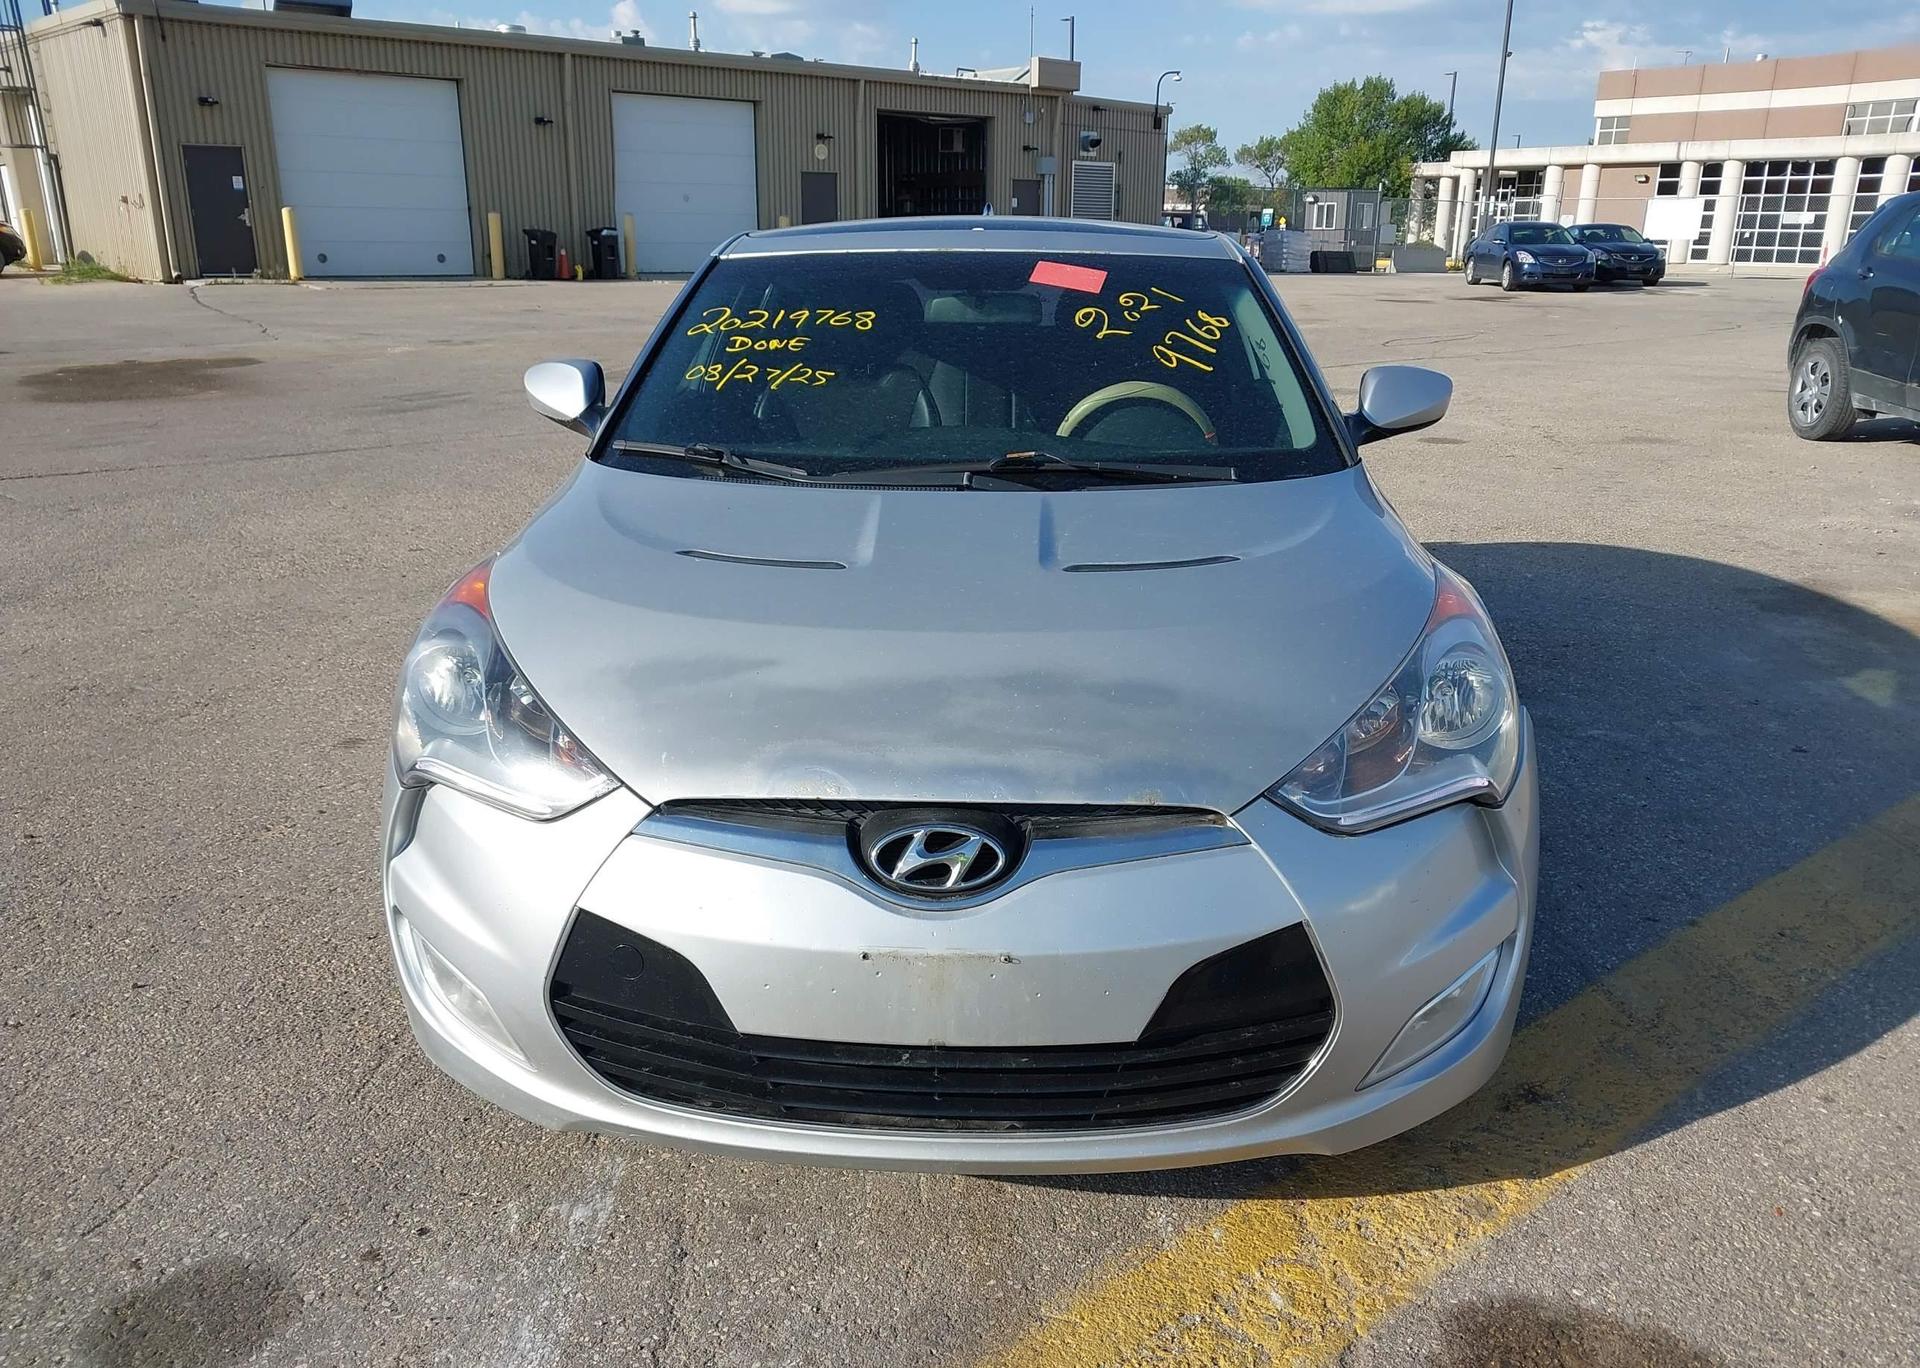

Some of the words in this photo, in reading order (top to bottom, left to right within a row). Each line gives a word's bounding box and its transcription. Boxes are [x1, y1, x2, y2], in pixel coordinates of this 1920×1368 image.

[686, 307, 877, 336] 20219768
[725, 335, 811, 352] DONE
[1152, 310, 1231, 371] 9768
[685, 358, 836, 392] 08/27/25
